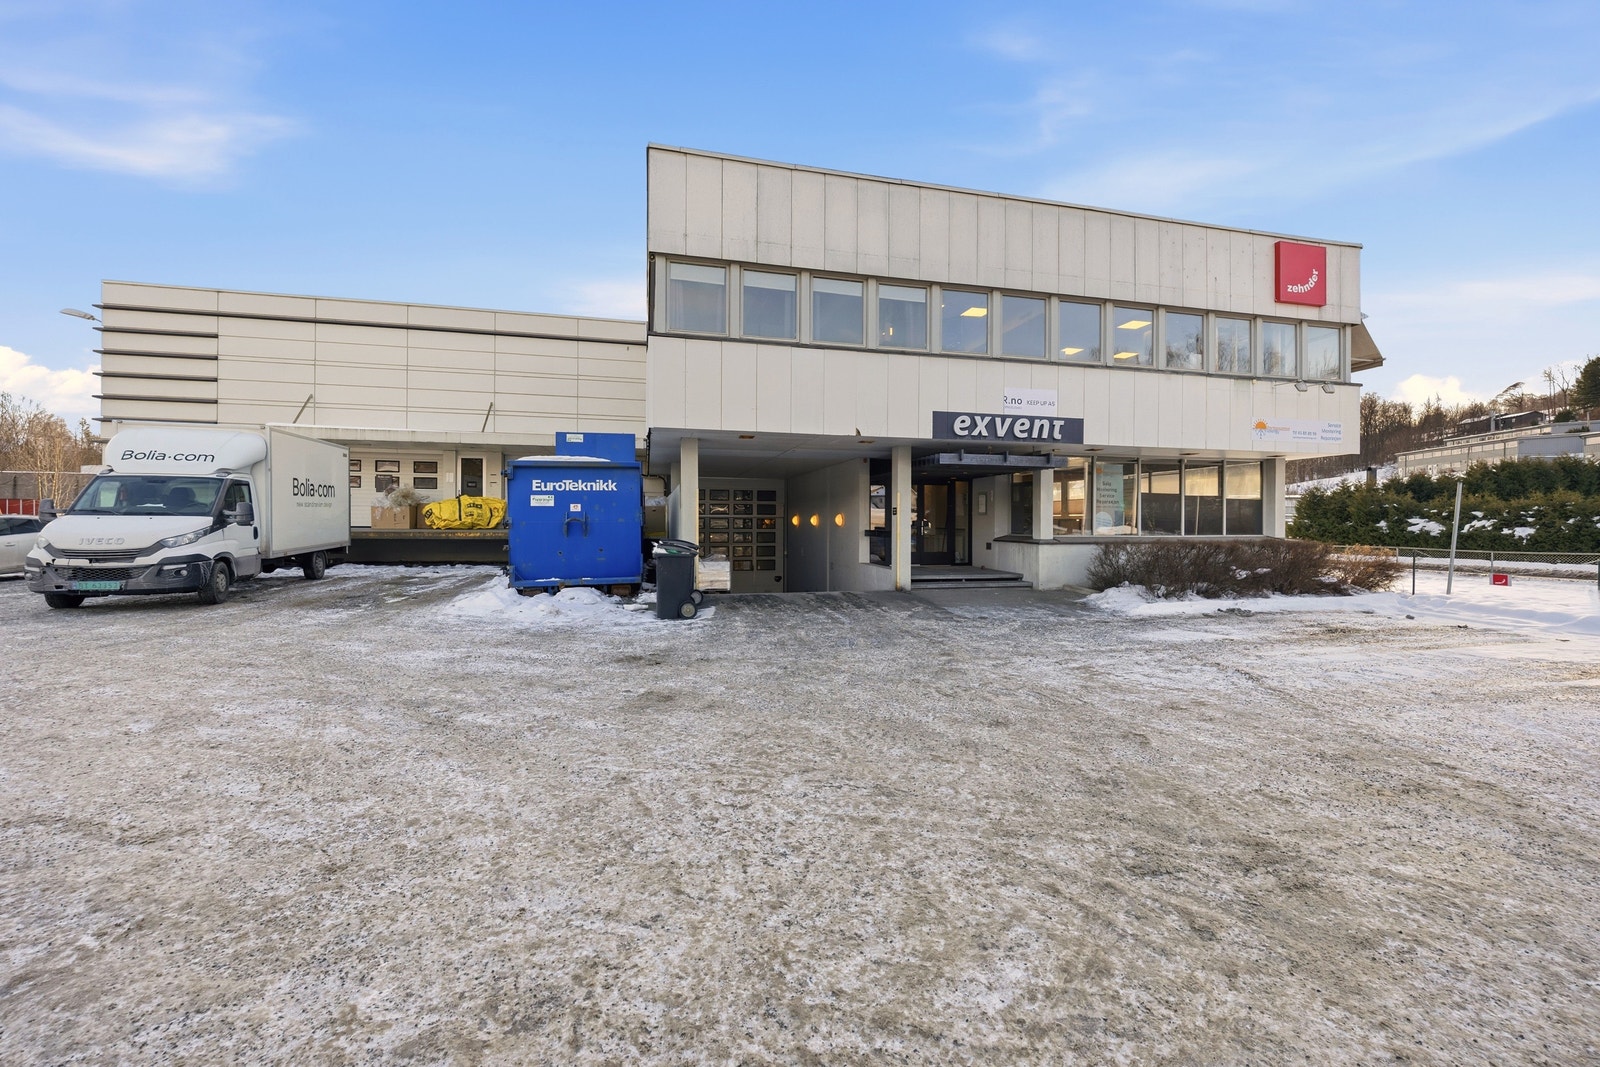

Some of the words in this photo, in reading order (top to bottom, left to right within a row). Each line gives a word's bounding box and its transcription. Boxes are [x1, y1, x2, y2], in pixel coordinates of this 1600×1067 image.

[1287, 268, 1319, 293] zehnder
[953, 415, 1065, 440] exvent
[532, 479, 617, 491] EuroTeknikk
[79, 537, 125, 545] IVECO
